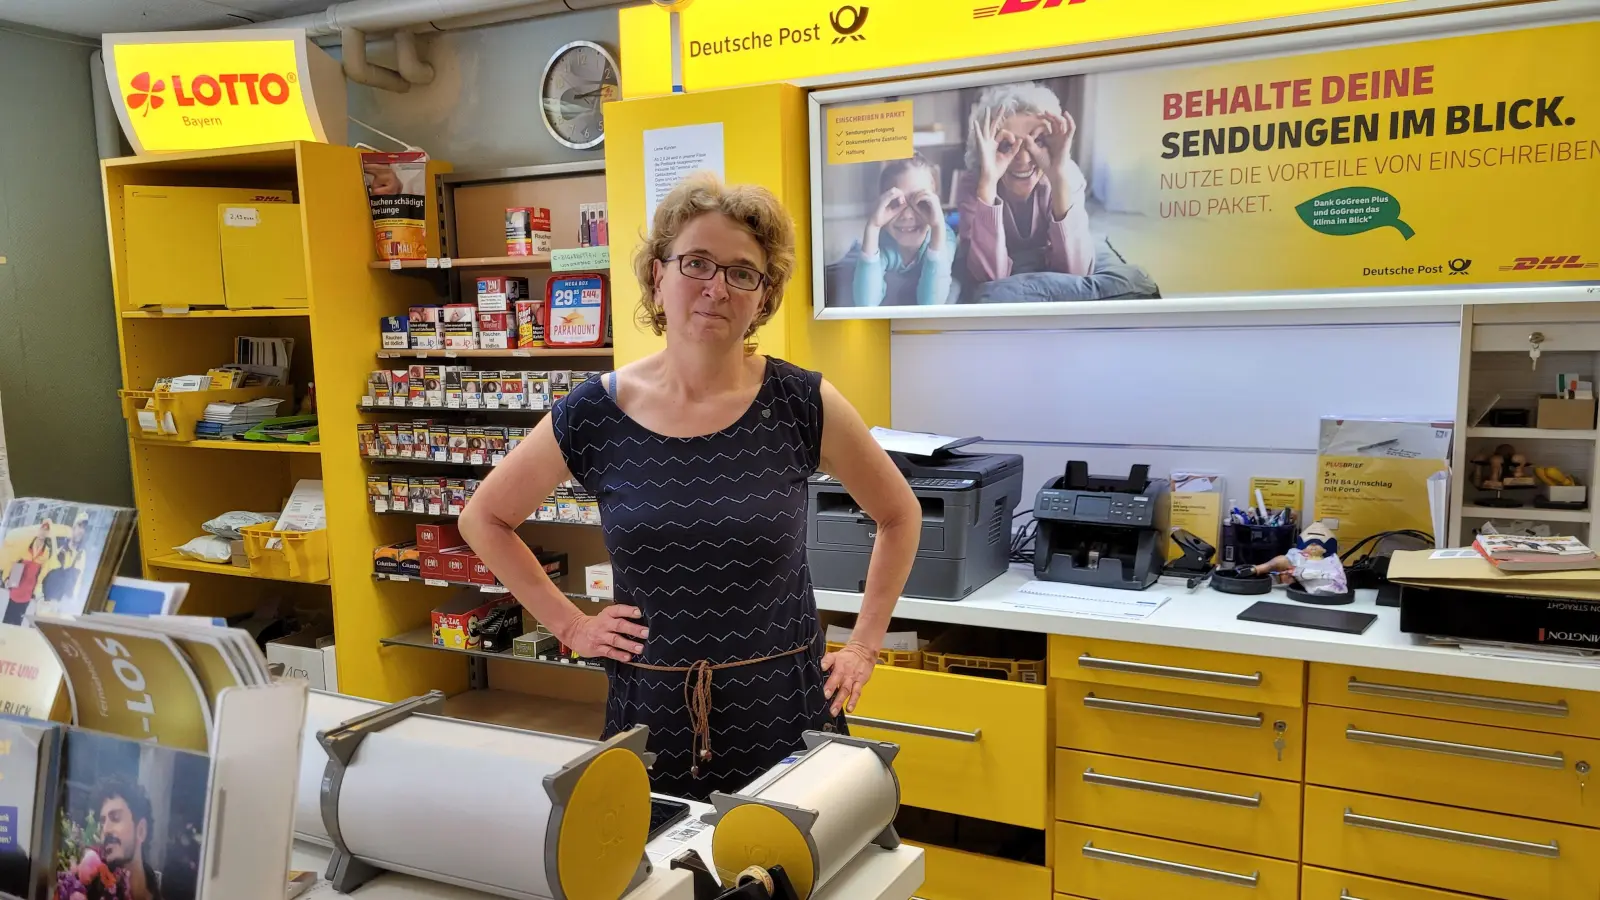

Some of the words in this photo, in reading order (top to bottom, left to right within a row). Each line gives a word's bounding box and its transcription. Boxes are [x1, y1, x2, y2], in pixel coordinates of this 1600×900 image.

[690, 30, 773, 58] Deutsche
[779, 23, 821, 46] Post
[171, 73, 289, 106] LOTTO
[1162, 79, 1312, 121] BEHALTE
[1321, 65, 1434, 105] DEINE
[885, 110, 906, 119] PAKET
[182, 116, 222, 128] Bayern
[1161, 112, 1379, 160] SENDUNGEN
[1389, 108, 1435, 140] IM
[1445, 95, 1576, 136] BLICK.
[1160, 168, 1223, 191] NUTZE
[1230, 166, 1260, 186] DIE
[1268, 157, 1368, 183] VORTEILE
[1374, 153, 1422, 175] VON
[394, 197, 424, 208] schädigt
[1159, 199, 1202, 219] UND
[1207, 194, 1272, 216] PAKET.
[1314, 199, 1334, 207] Dank
[1335, 197, 1370, 206] GoGreen
[1371, 195, 1389, 204] Plus
[381, 207, 400, 215] Lunge
[1330, 207, 1364, 215] GoGreen
[1313, 218, 1336, 226] Klima
[1512, 255, 1586, 271] DHL
[1362, 266, 1414, 277] Deutsche
[1417, 264, 1443, 274] Post
[555, 289, 573, 306] 29
[553, 324, 596, 336] PARAMOUNT
[1323, 485, 1337, 493] mit
[1353, 479, 1393, 489] Umschlag
[401, 562, 420, 570] Columbu
[1547, 602, 1588, 611] STRAIGHT
